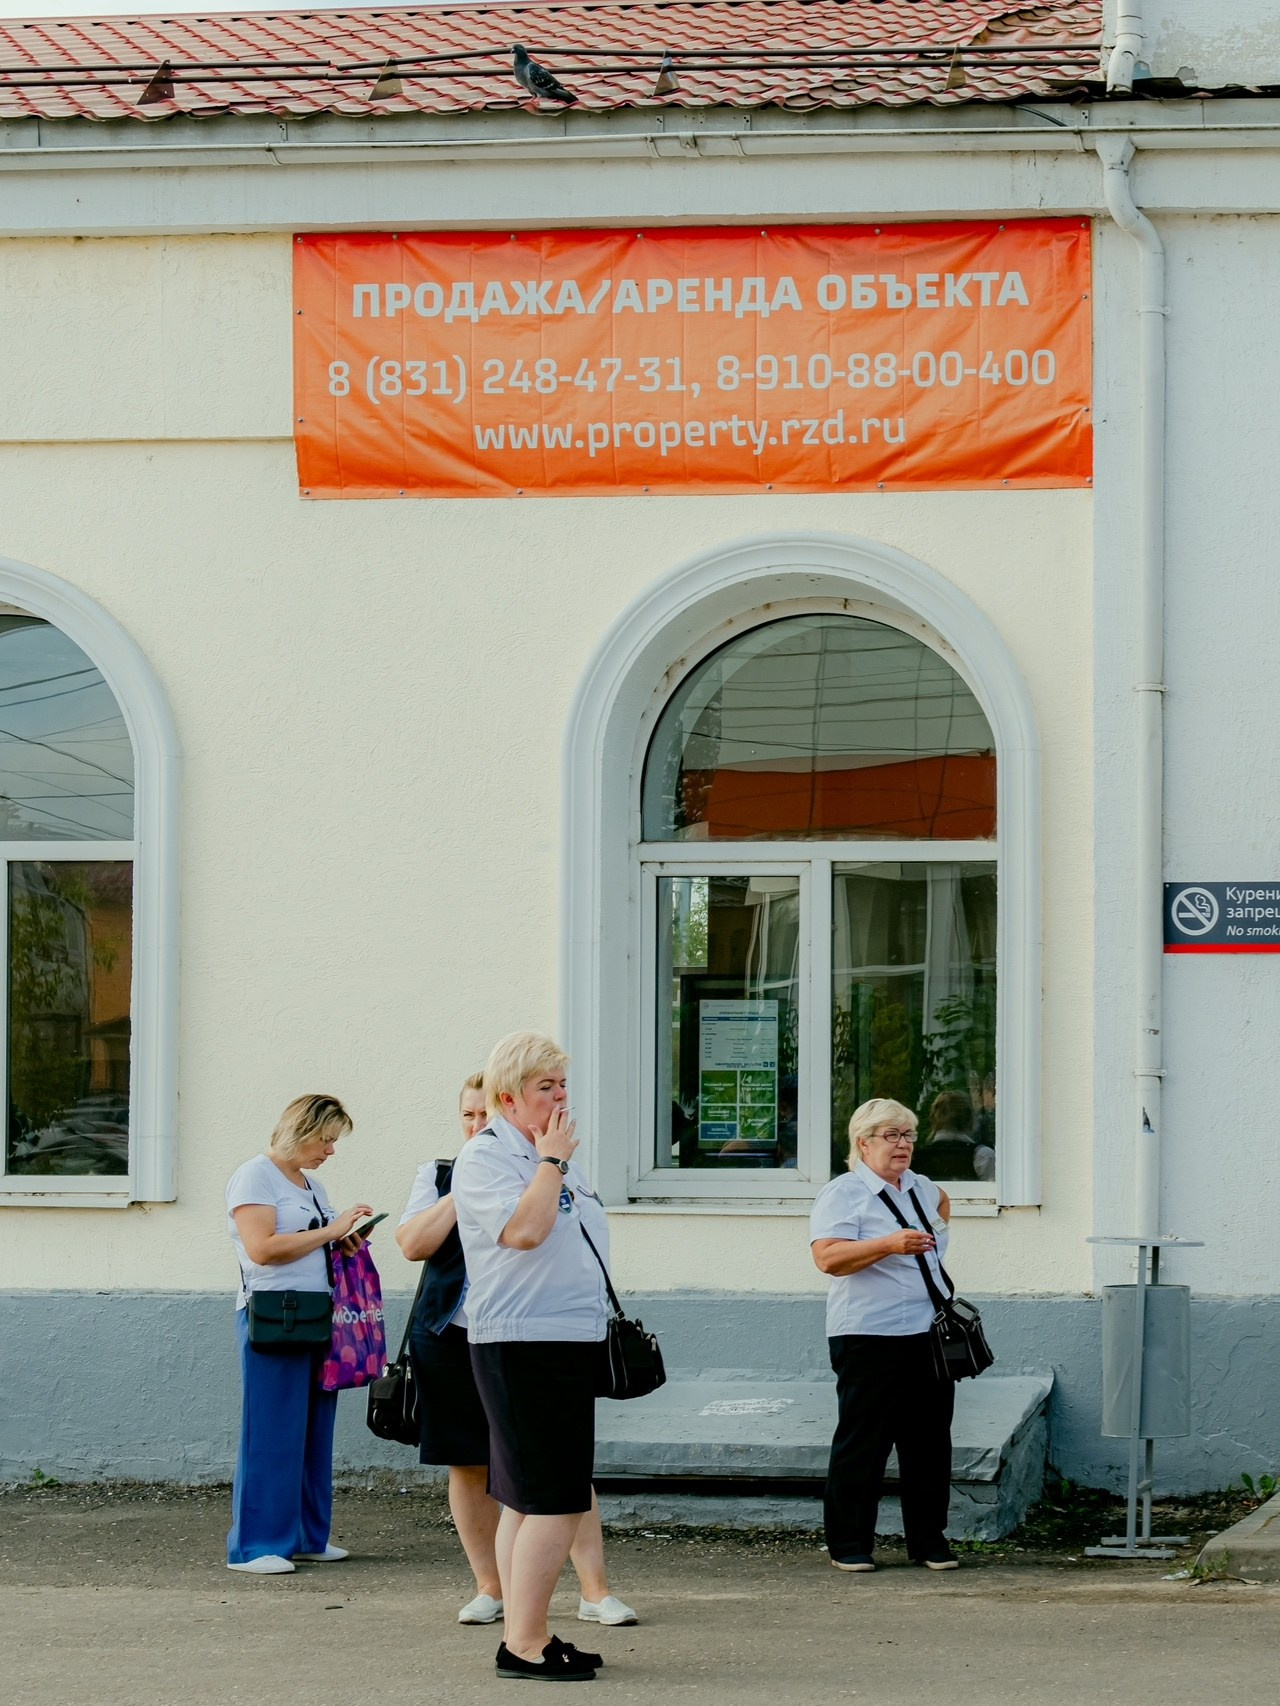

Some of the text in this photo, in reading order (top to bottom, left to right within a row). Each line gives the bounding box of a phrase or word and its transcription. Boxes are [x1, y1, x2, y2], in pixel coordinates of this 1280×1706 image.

[352, 271, 1029, 323] ПРОДАЖА/АРЕНДА ОБЪЕКТА
[328, 349, 1055, 404] 8 (831) 248-47-31, 8-910-88-00-400
[474, 408, 906, 457] www.property.rzd.ru
[1226, 925, 1244, 936] No
